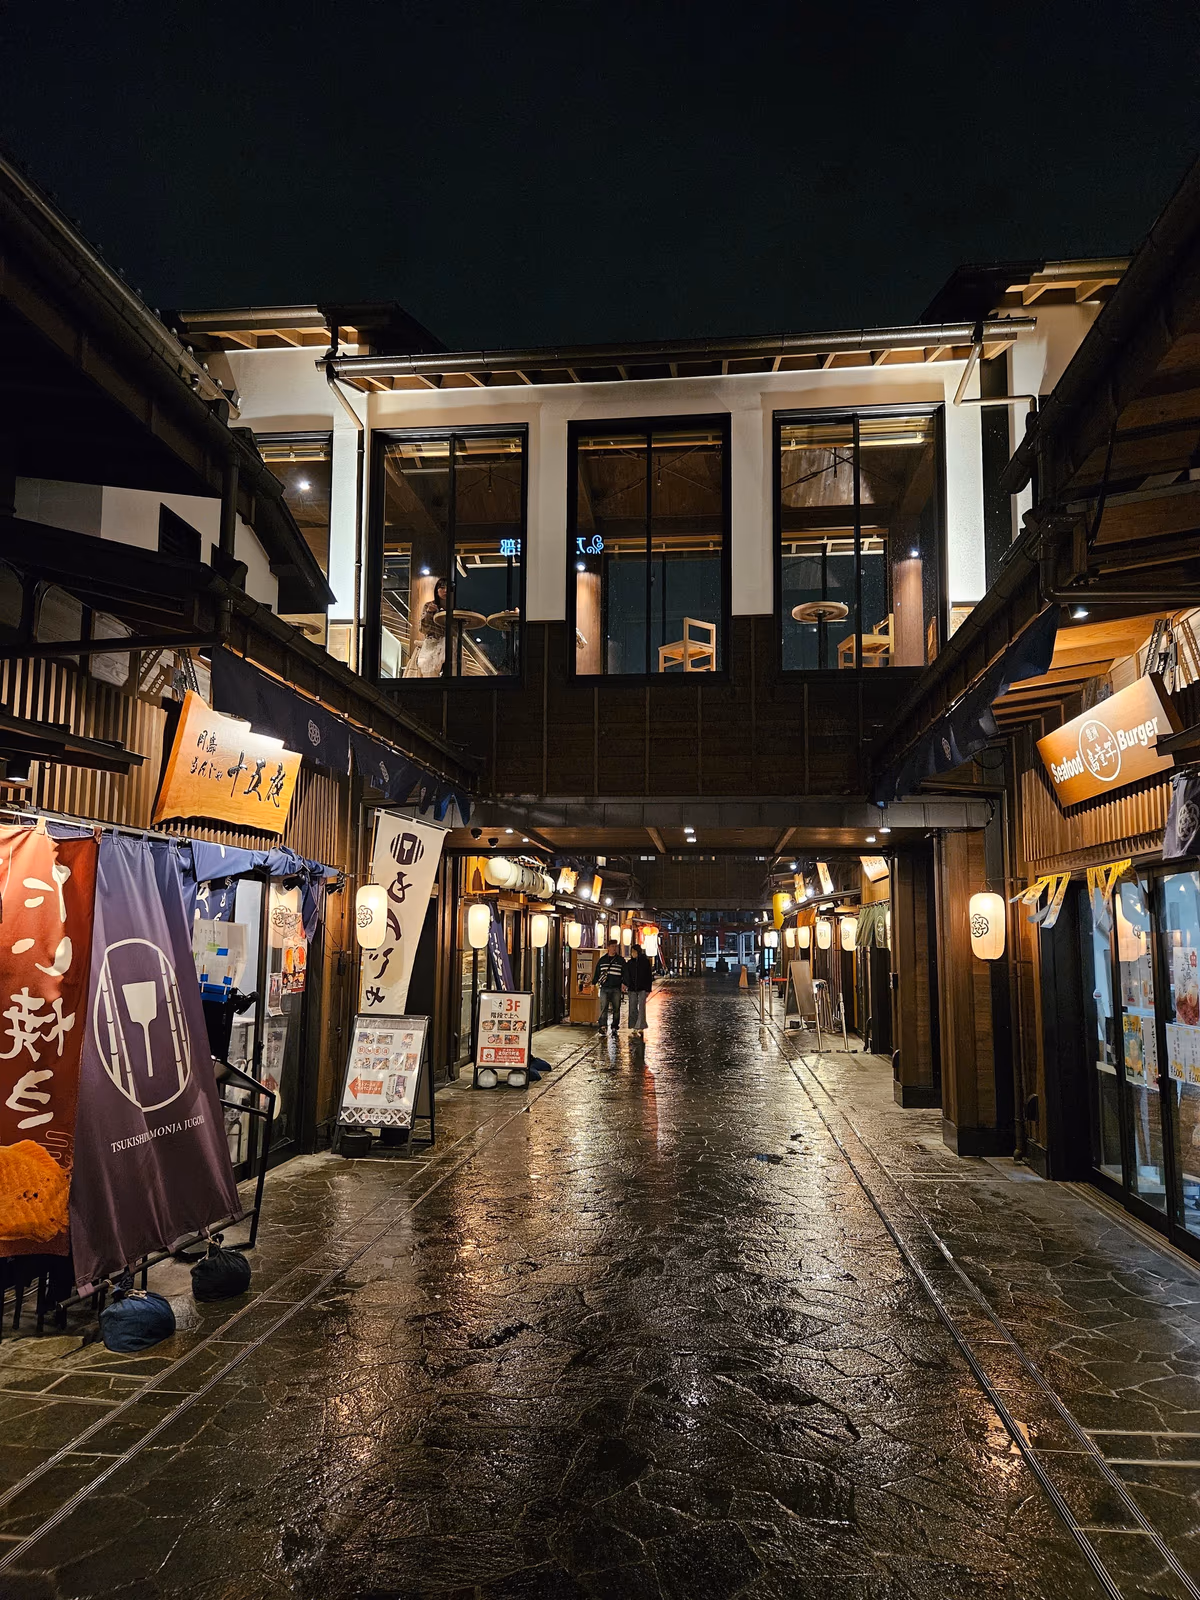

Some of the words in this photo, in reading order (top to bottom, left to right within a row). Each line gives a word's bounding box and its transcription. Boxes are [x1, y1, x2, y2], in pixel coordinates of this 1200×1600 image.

[1050, 751, 1085, 784] Seafood
[1116, 717, 1159, 751] Burger
[505, 998, 521, 1012] 3F
